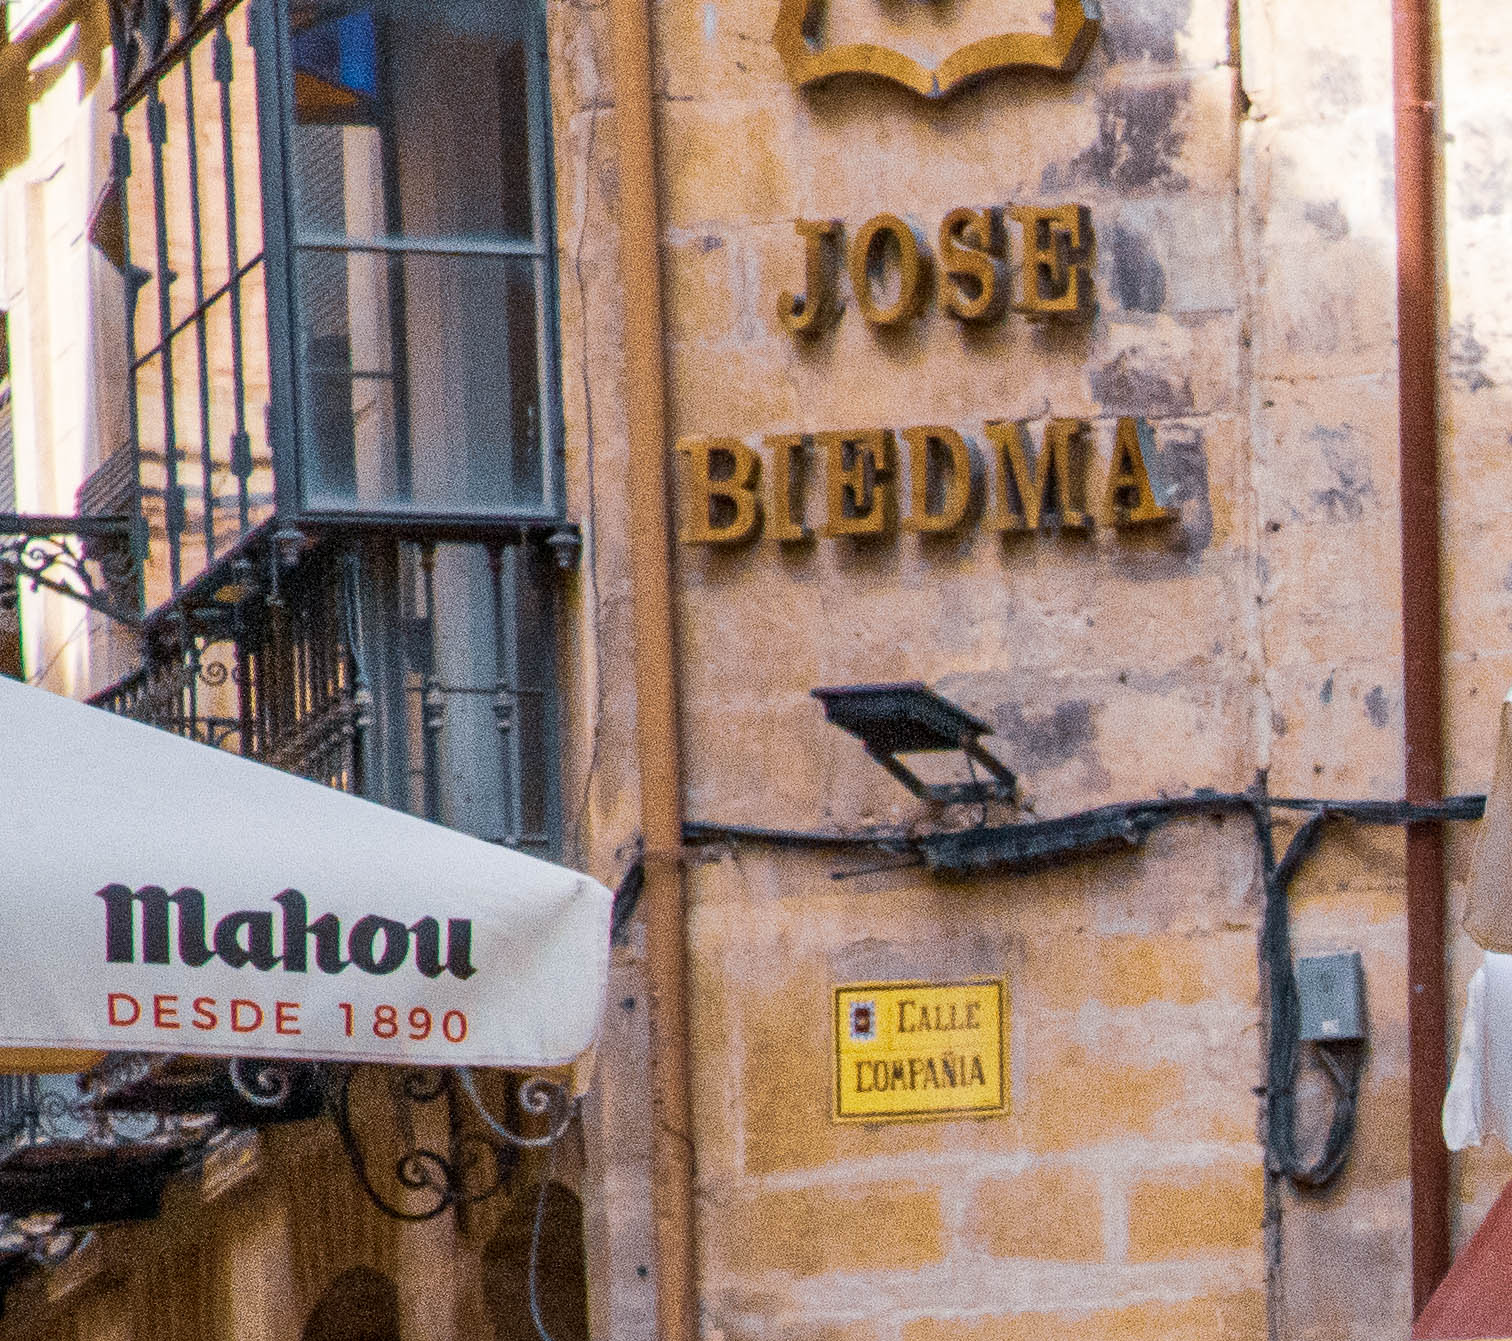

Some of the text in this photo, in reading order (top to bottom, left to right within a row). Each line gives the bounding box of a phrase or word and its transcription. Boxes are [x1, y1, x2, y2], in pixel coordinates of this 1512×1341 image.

[777, 202, 1094, 332] JOSE
[676, 416, 1178, 545] BIEDMA
[95, 883, 477, 980] Mahou
[107, 992, 470, 1043] DESDE 1890
[897, 1000, 982, 1033] CALLE
